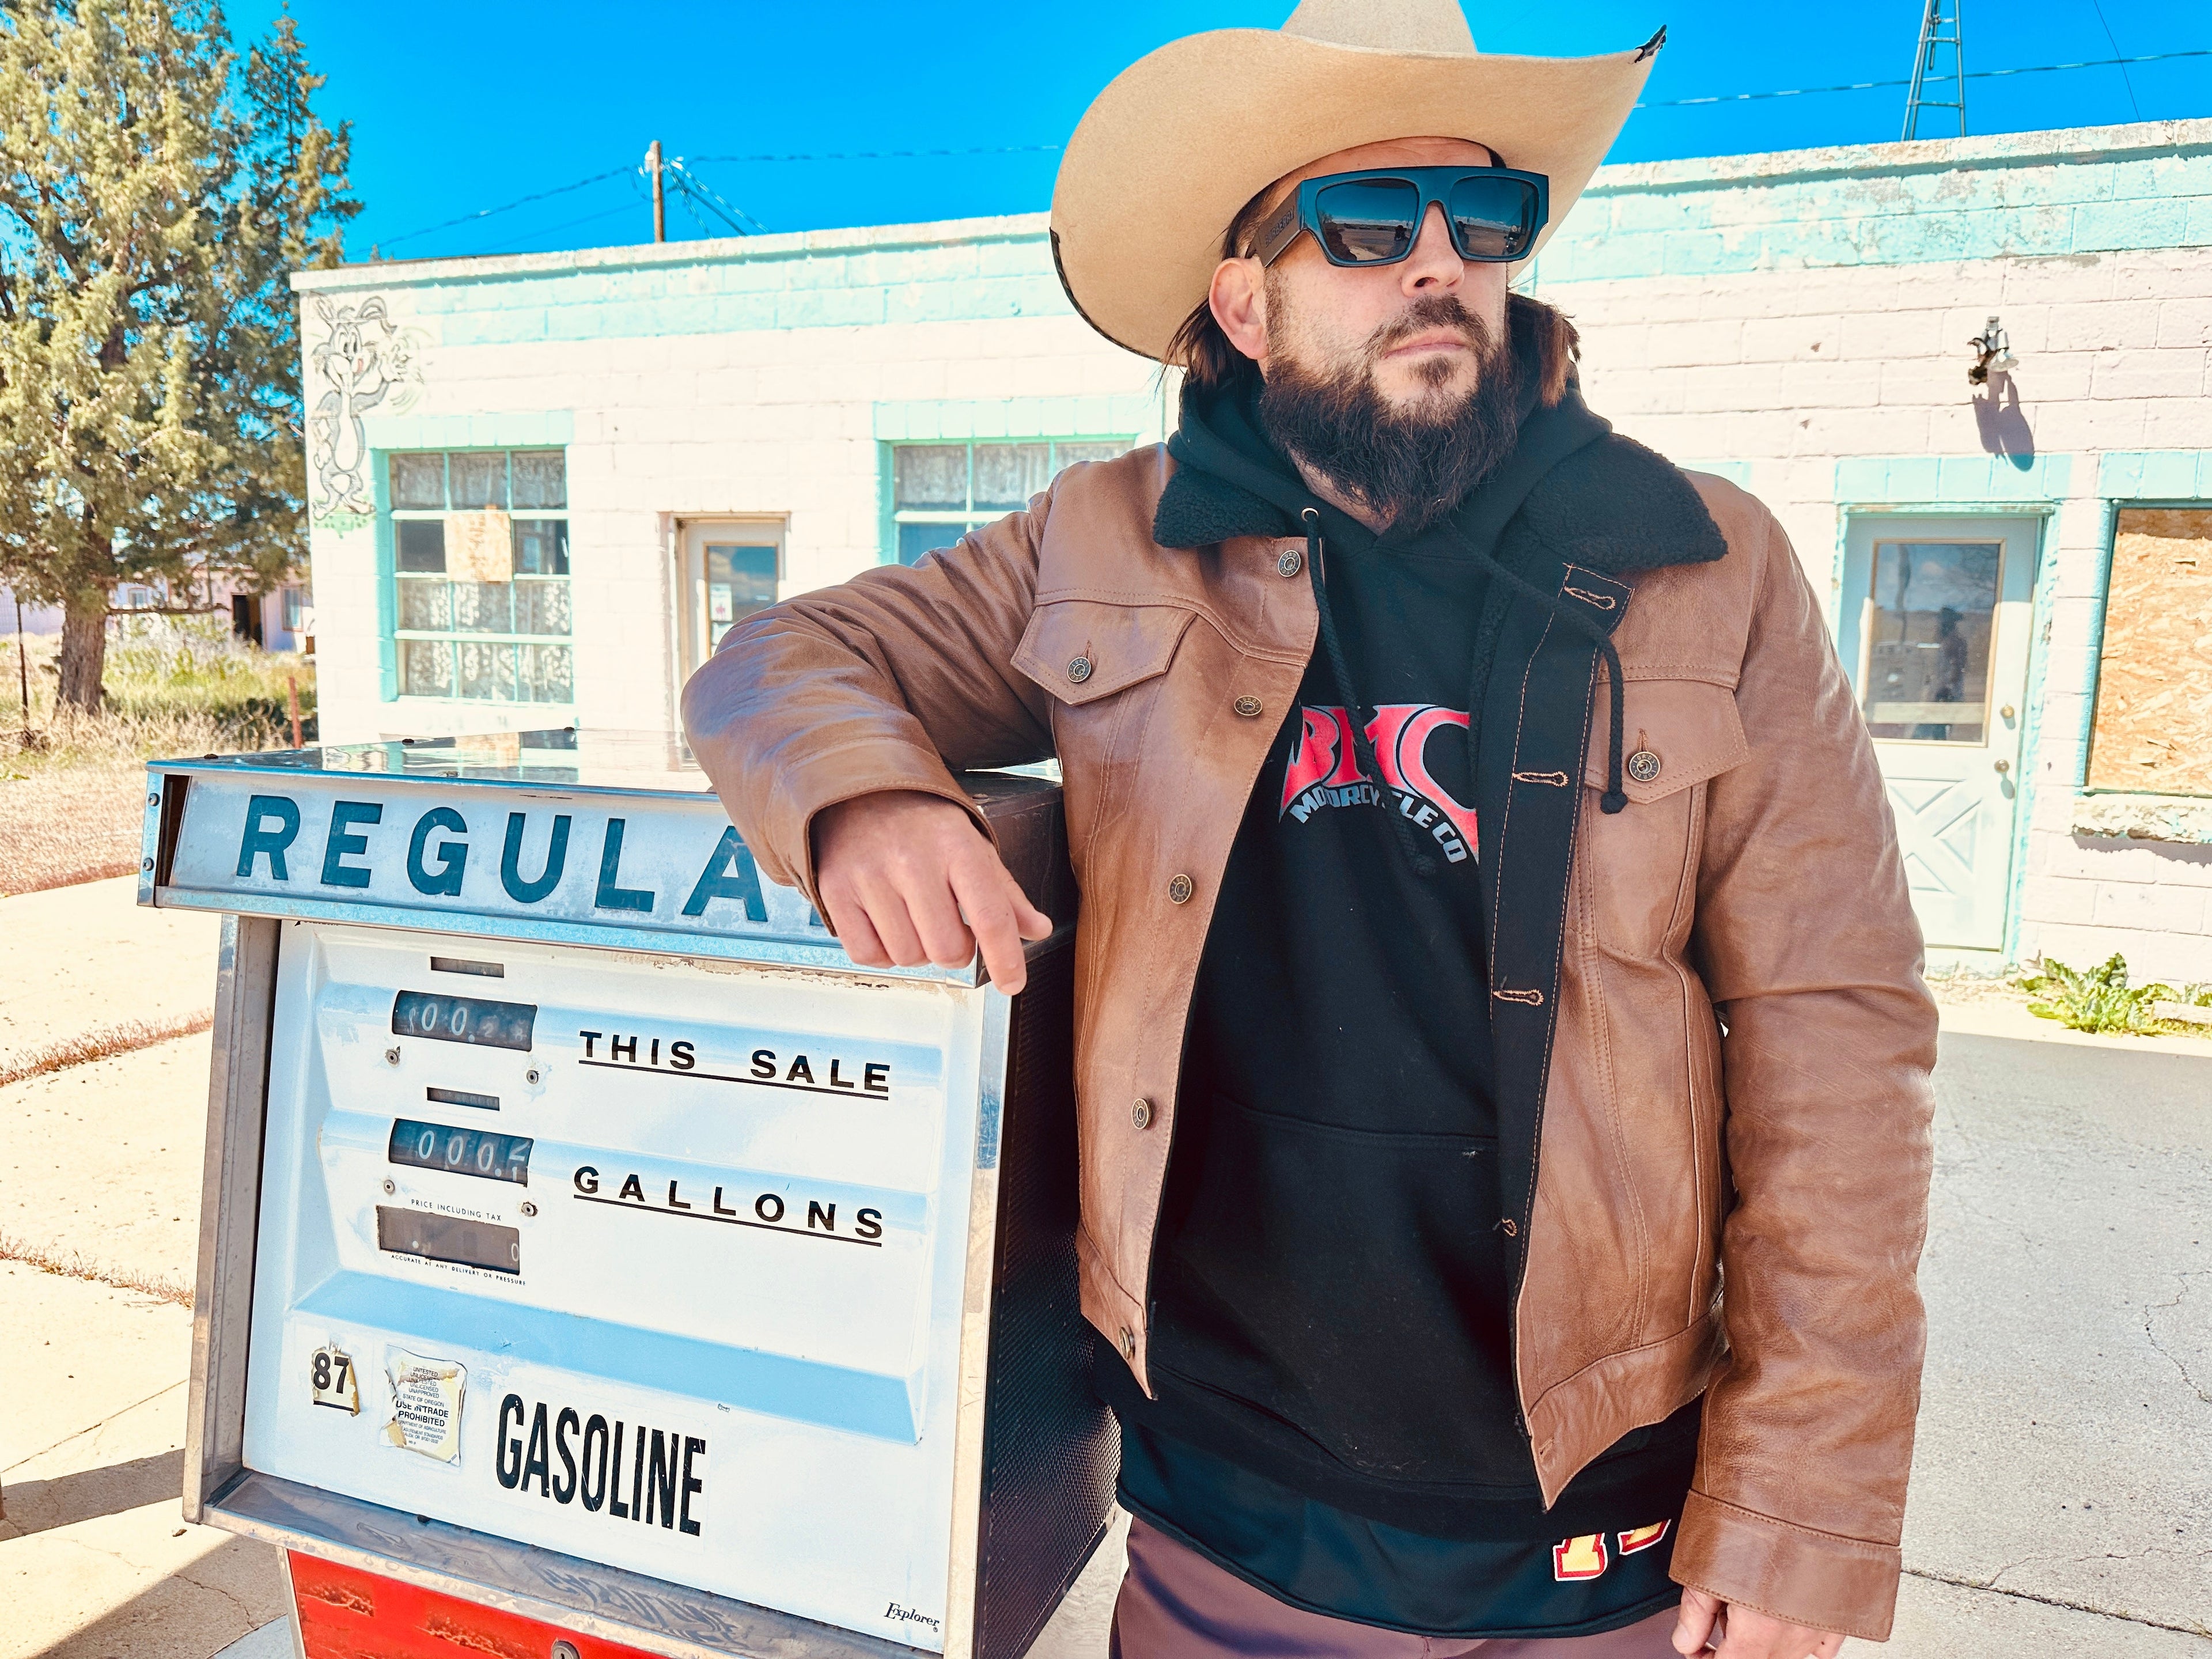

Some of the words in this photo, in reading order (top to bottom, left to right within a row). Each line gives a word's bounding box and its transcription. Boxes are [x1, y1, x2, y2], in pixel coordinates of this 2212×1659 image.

[1432, 822, 1467, 863] CO
[237, 794, 834, 927] REGULA
[579, 1031, 695, 1069] THIS
[751, 1050, 890, 1092] SALE
[411, 1199, 433, 1209] PRICE
[437, 1203, 481, 1218] INCLUDING
[486, 1213, 501, 1221] TAX
[574, 1166, 882, 1238] GALLONS
[391, 1254, 421, 1264] ACCURATE
[452, 1266, 480, 1276] DELIVERY
[496, 1275, 526, 1286] PRESSURE
[313, 1352, 349, 1394] 87
[413, 1366, 438, 1377] UNTESTED
[408, 1387, 440, 1399] UNAPPROVED
[410, 1382, 439, 1393] UNLICENSED
[396, 1400, 411, 1410] USE
[422, 1406, 449, 1418] TRADE
[424, 1399, 444, 1407] OREGON
[398, 1410, 445, 1427] PROHIBITED
[497, 1393, 706, 1536] GASOLINE
[884, 1602, 940, 1627] Explorer
